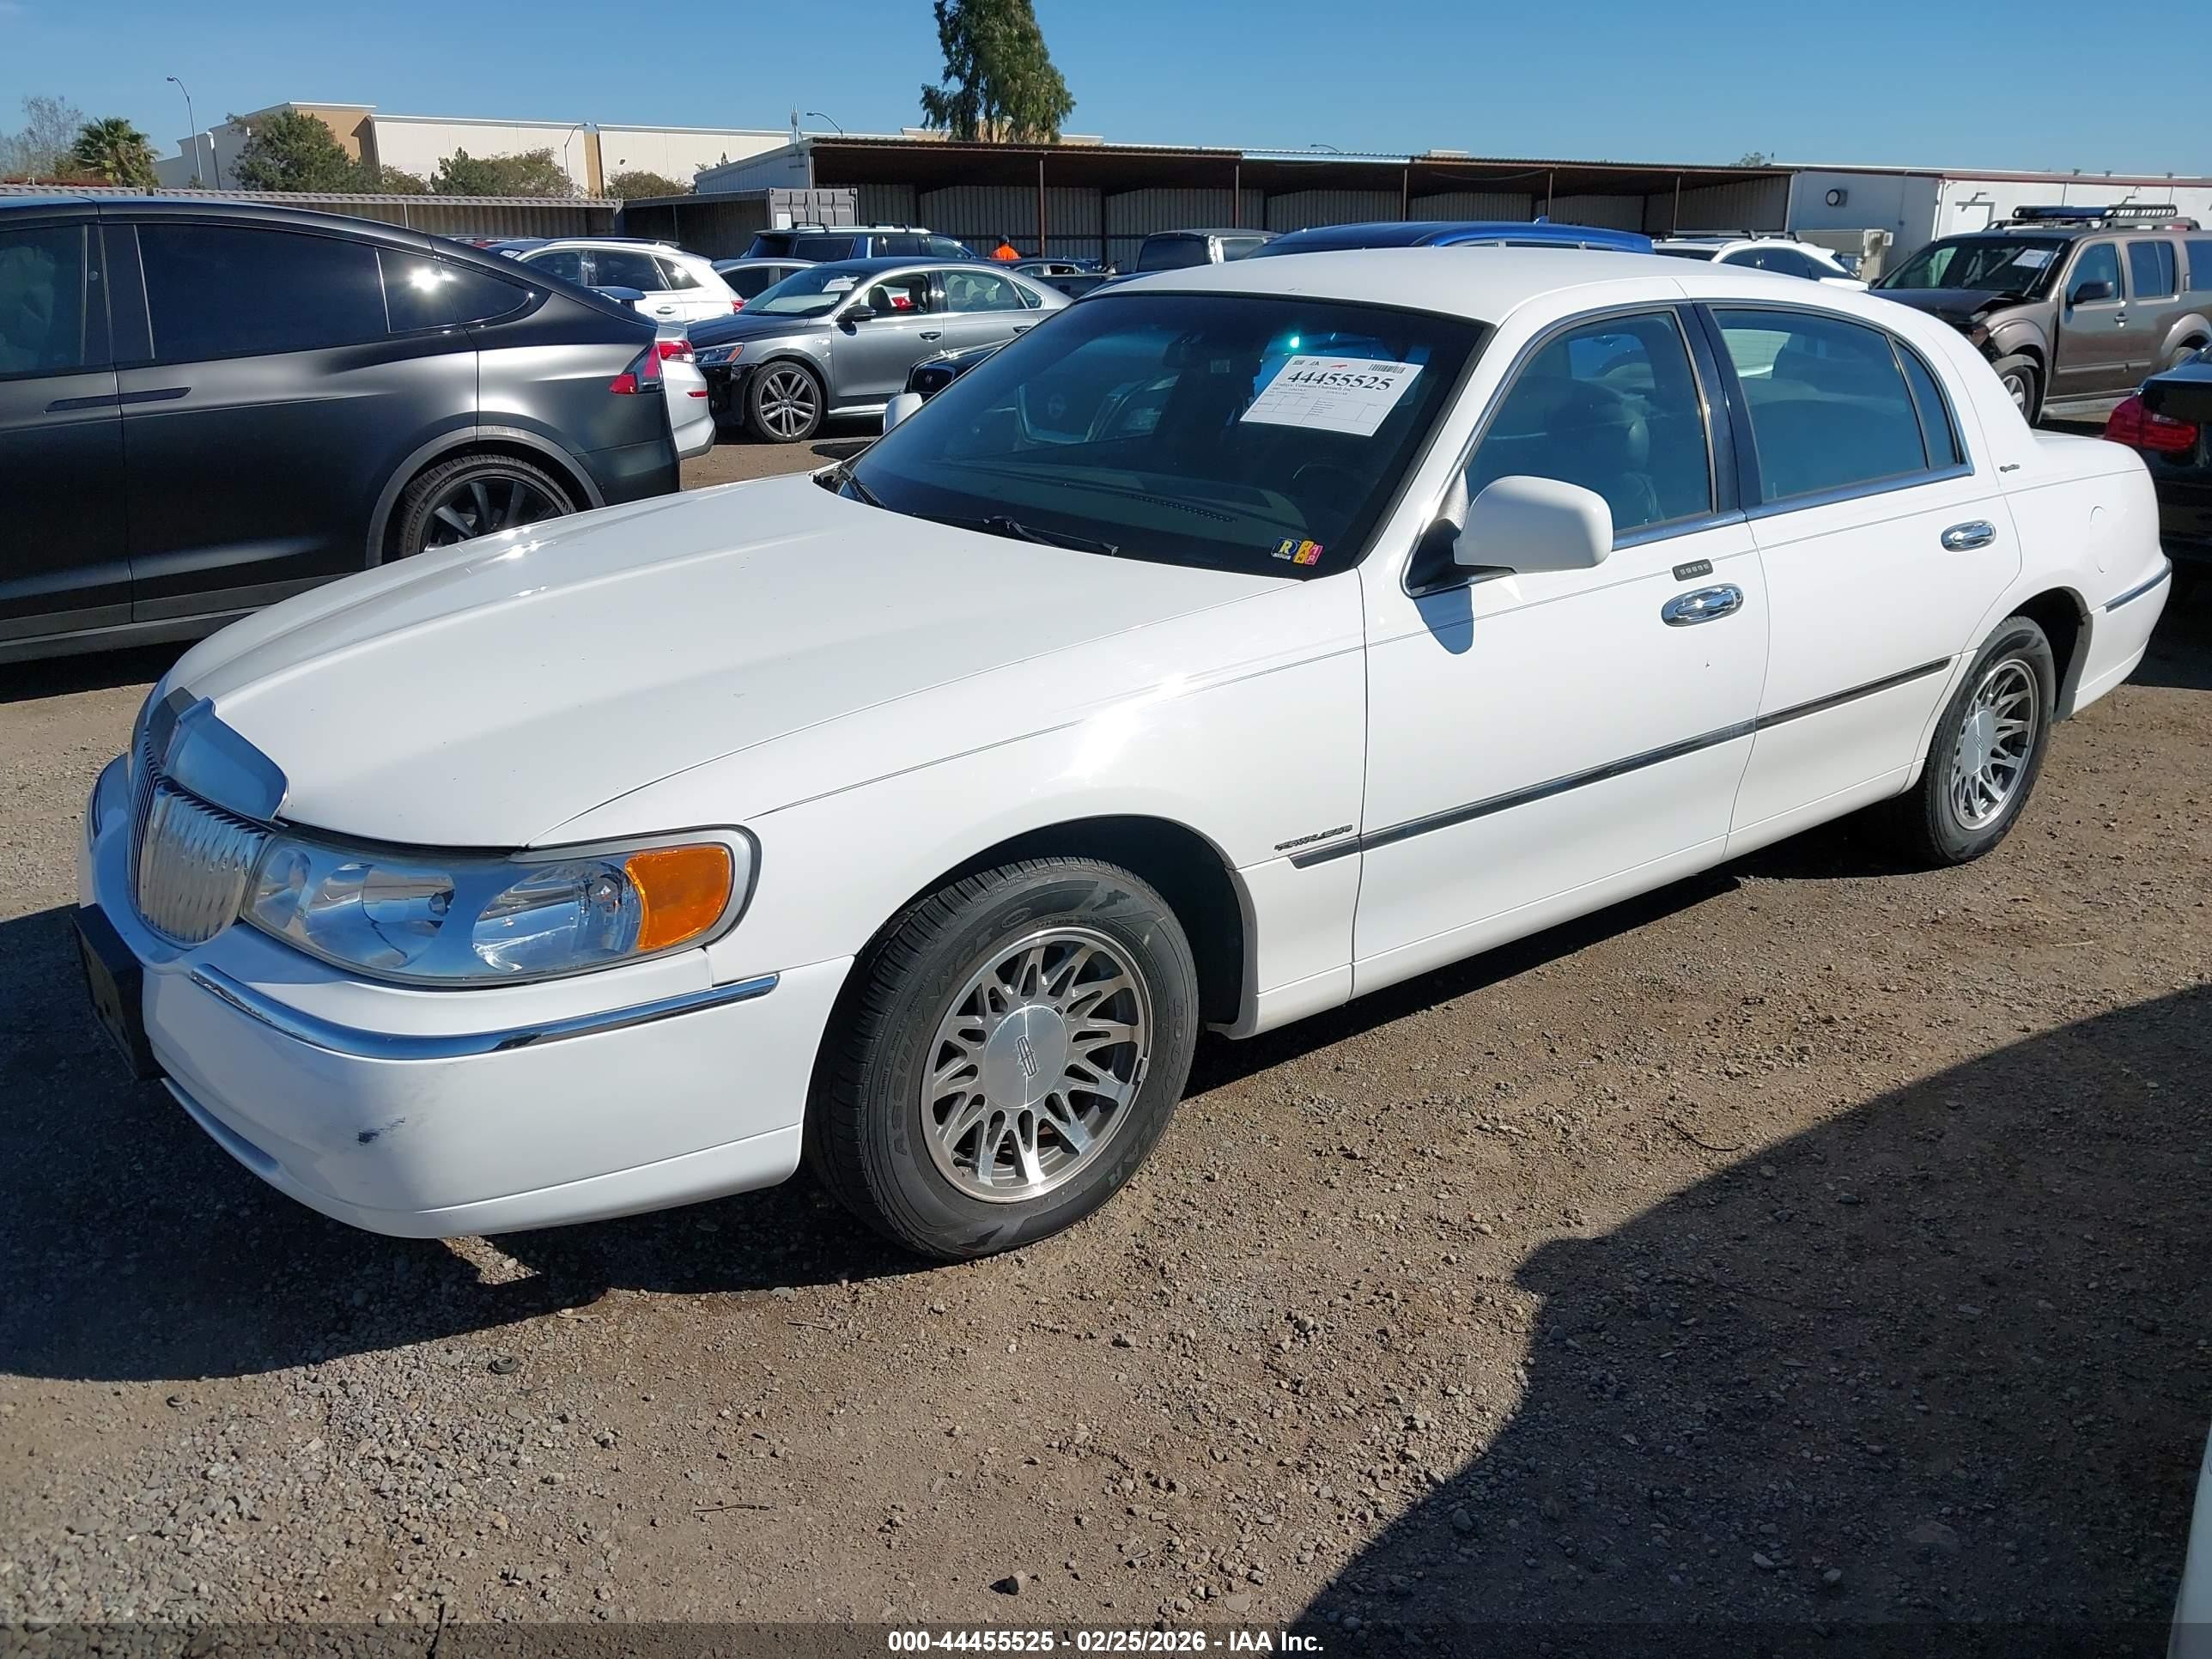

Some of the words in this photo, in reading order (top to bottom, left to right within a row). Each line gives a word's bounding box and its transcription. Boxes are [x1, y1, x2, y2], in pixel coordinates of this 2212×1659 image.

[1288, 370, 1395, 391] 44455525
[1279, 539, 1293, 555] R
[1297, 542, 1310, 562] JAN
